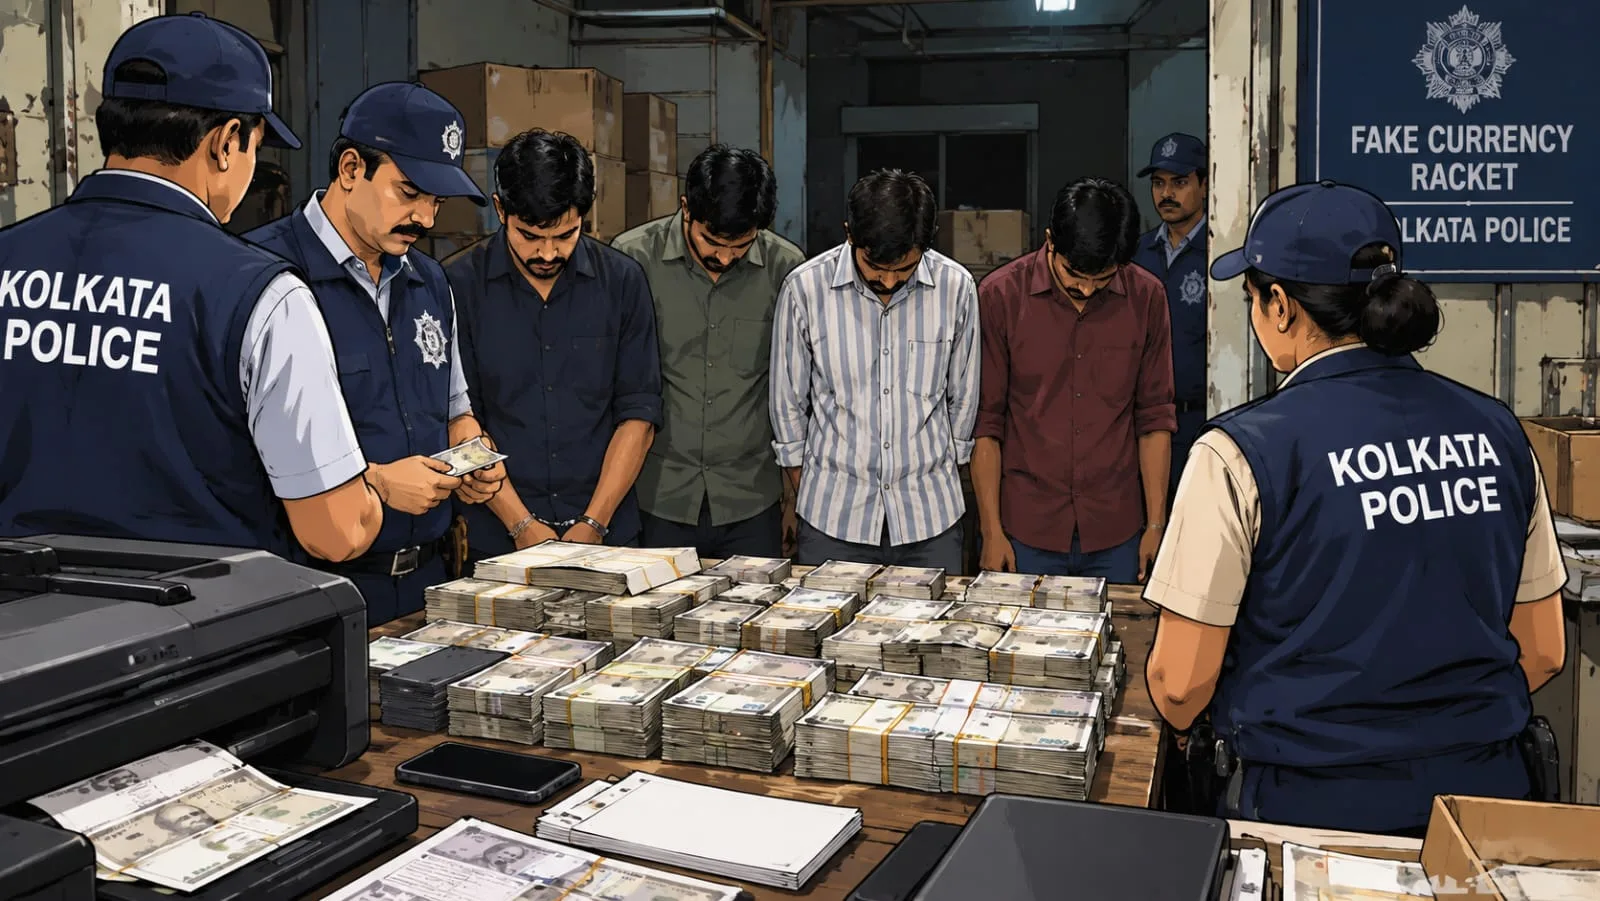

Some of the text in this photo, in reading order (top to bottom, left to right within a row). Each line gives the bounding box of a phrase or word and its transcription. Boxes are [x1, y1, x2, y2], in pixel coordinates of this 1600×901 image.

[1351, 124, 1574, 154] FAKE CURRENCY
[1411, 162, 1518, 191] RACKET
[1397, 216, 1572, 243] LKATA POLICE
[0, 269, 172, 323] KOLKATA
[3, 318, 162, 374] POLICE
[1327, 433, 1501, 487] KOLKATA
[1360, 476, 1501, 530] POLICE
